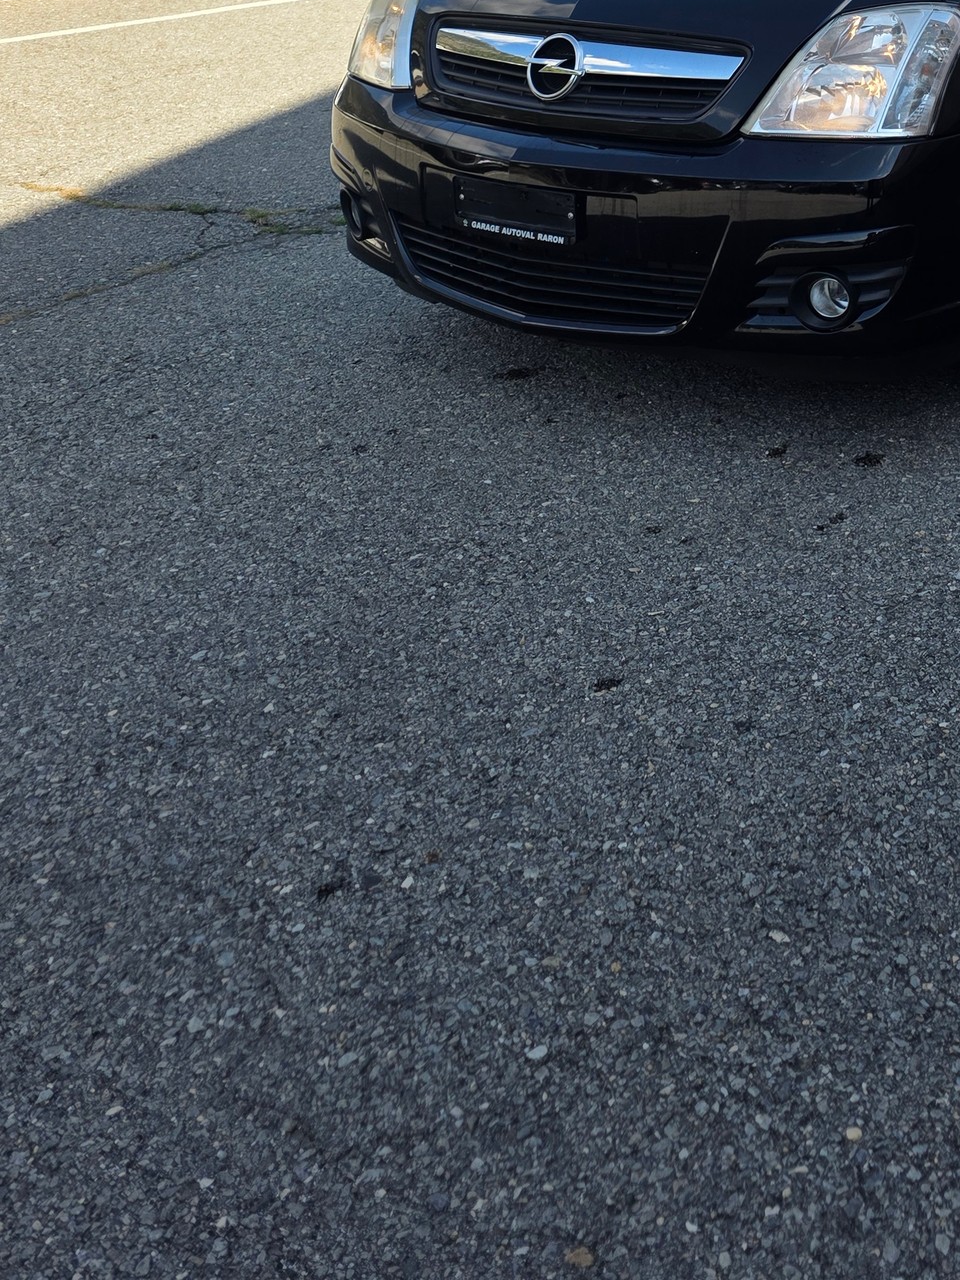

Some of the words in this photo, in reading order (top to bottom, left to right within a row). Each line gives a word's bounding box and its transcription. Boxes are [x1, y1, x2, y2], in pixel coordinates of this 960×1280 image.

[471, 221, 500, 233] GARAGE
[501, 227, 535, 240] AUTOVAL
[537, 233, 565, 245] RARON
